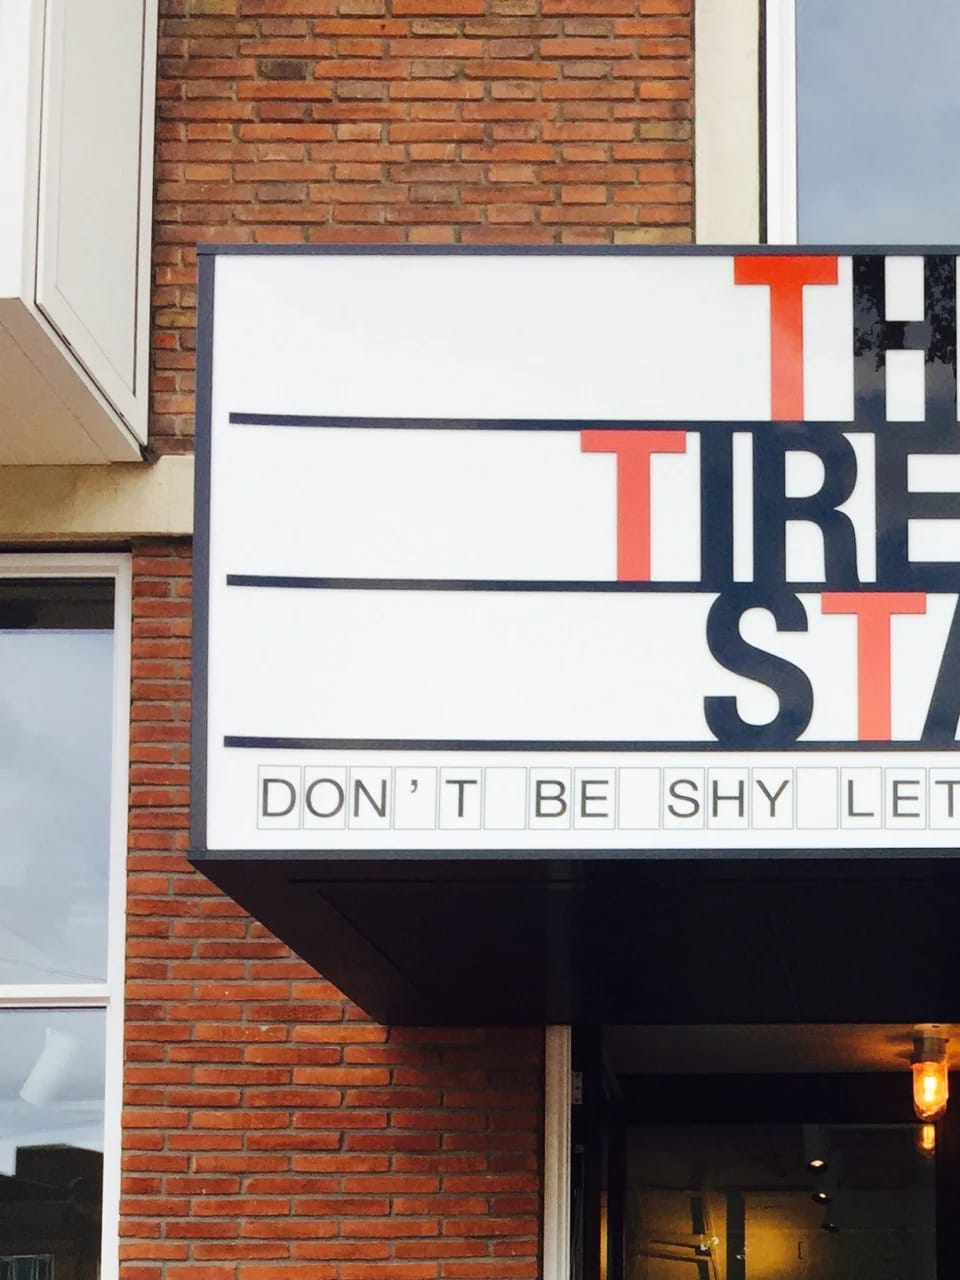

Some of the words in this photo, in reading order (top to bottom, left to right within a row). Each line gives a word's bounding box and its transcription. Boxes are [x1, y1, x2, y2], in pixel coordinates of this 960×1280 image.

[262, 778, 478, 818] DON'T
[535, 780, 609, 818] BE
[668, 779, 791, 818] SHY
